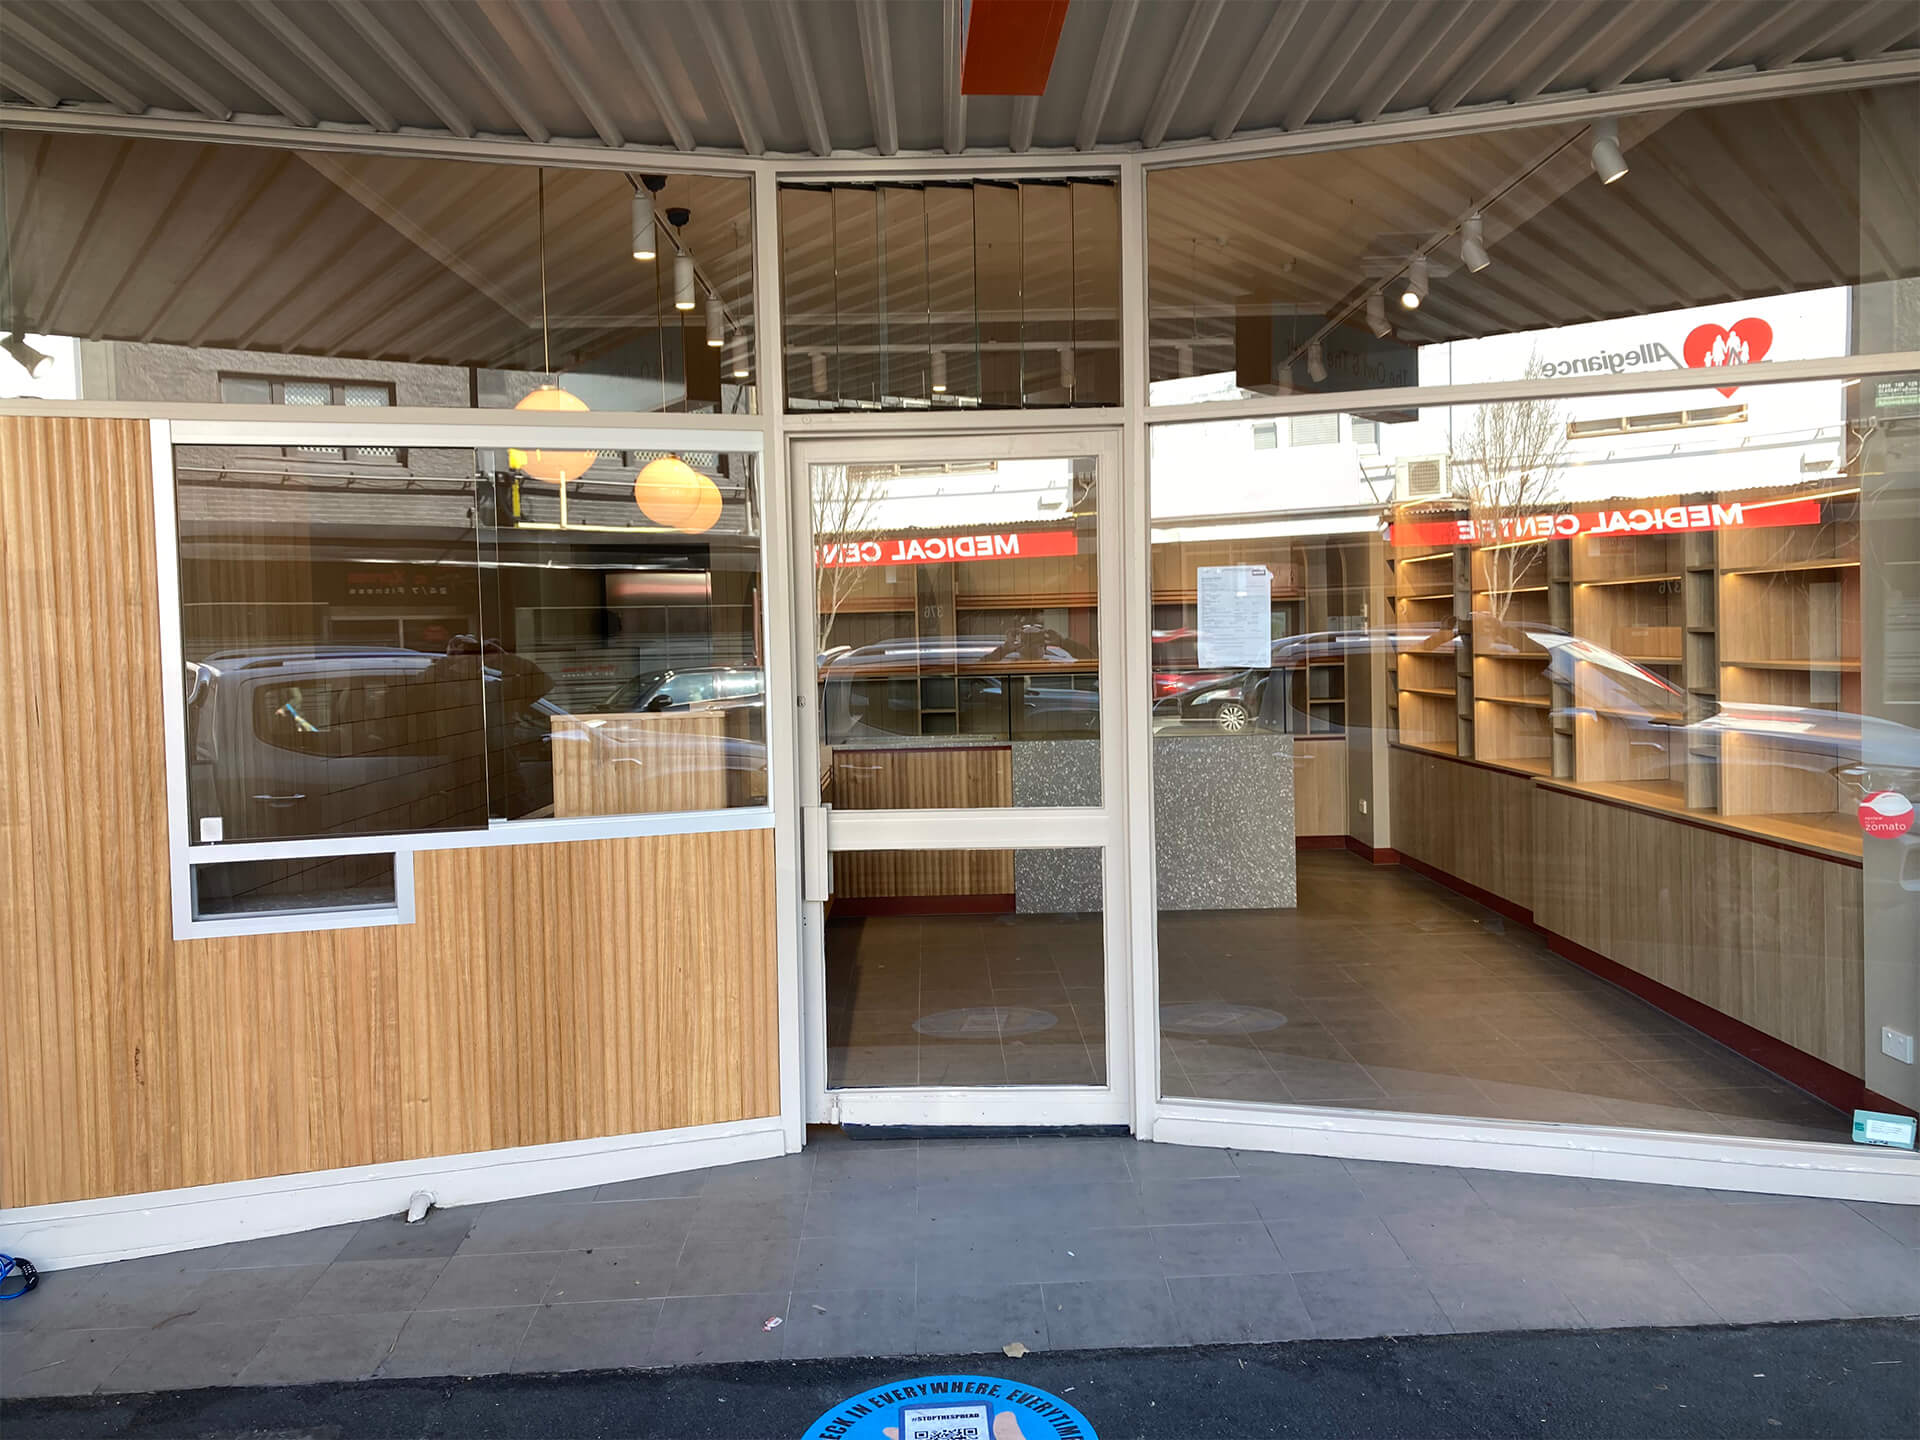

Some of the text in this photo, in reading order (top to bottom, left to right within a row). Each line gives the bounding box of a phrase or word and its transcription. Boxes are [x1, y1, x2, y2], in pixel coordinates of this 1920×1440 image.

[1865, 822, 1906, 831] zomato
[845, 1404, 873, 1419] IN
[868, 1381, 1002, 1409] EVERYWHERE,
